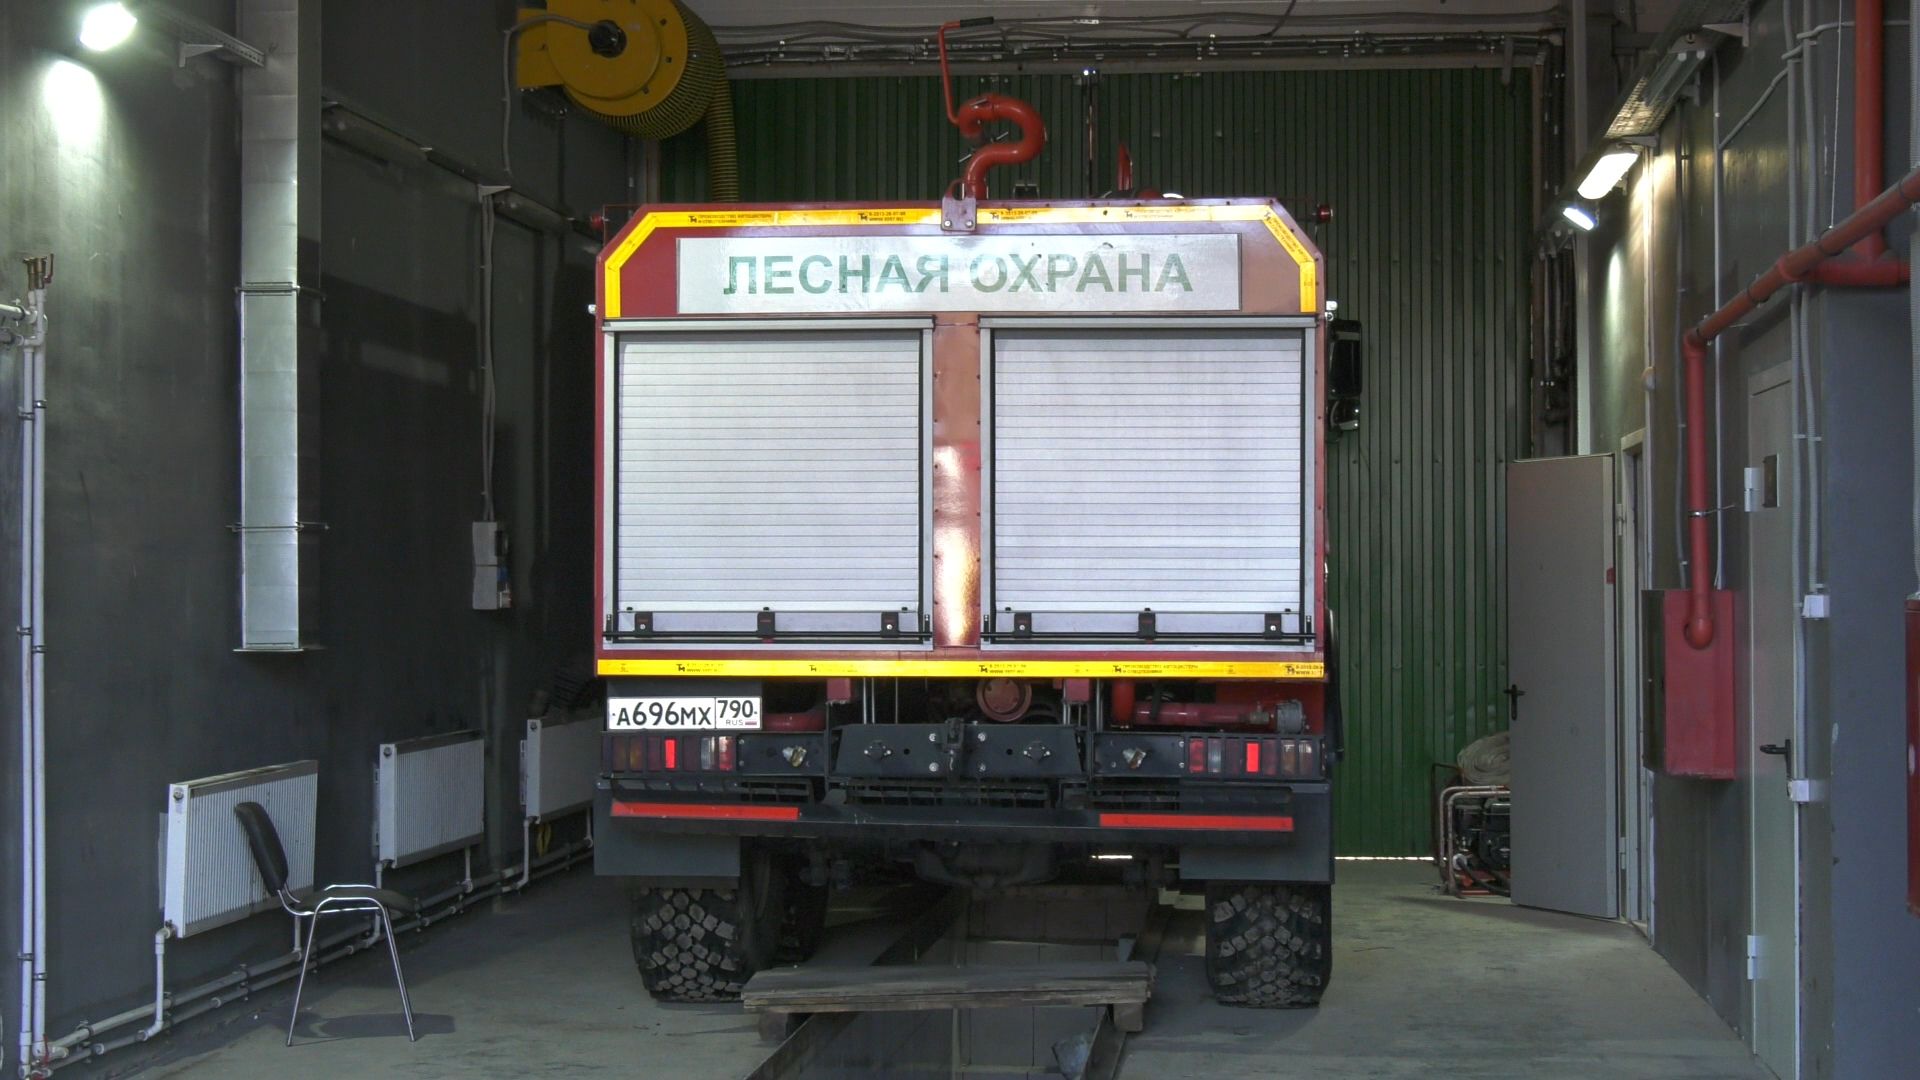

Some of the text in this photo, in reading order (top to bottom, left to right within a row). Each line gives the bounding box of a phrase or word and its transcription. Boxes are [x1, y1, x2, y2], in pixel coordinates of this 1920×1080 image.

[723, 253, 1194, 295] ЛЕСНАЯ ОХРАНА
[616, 699, 754, 726] А696МХ 790
